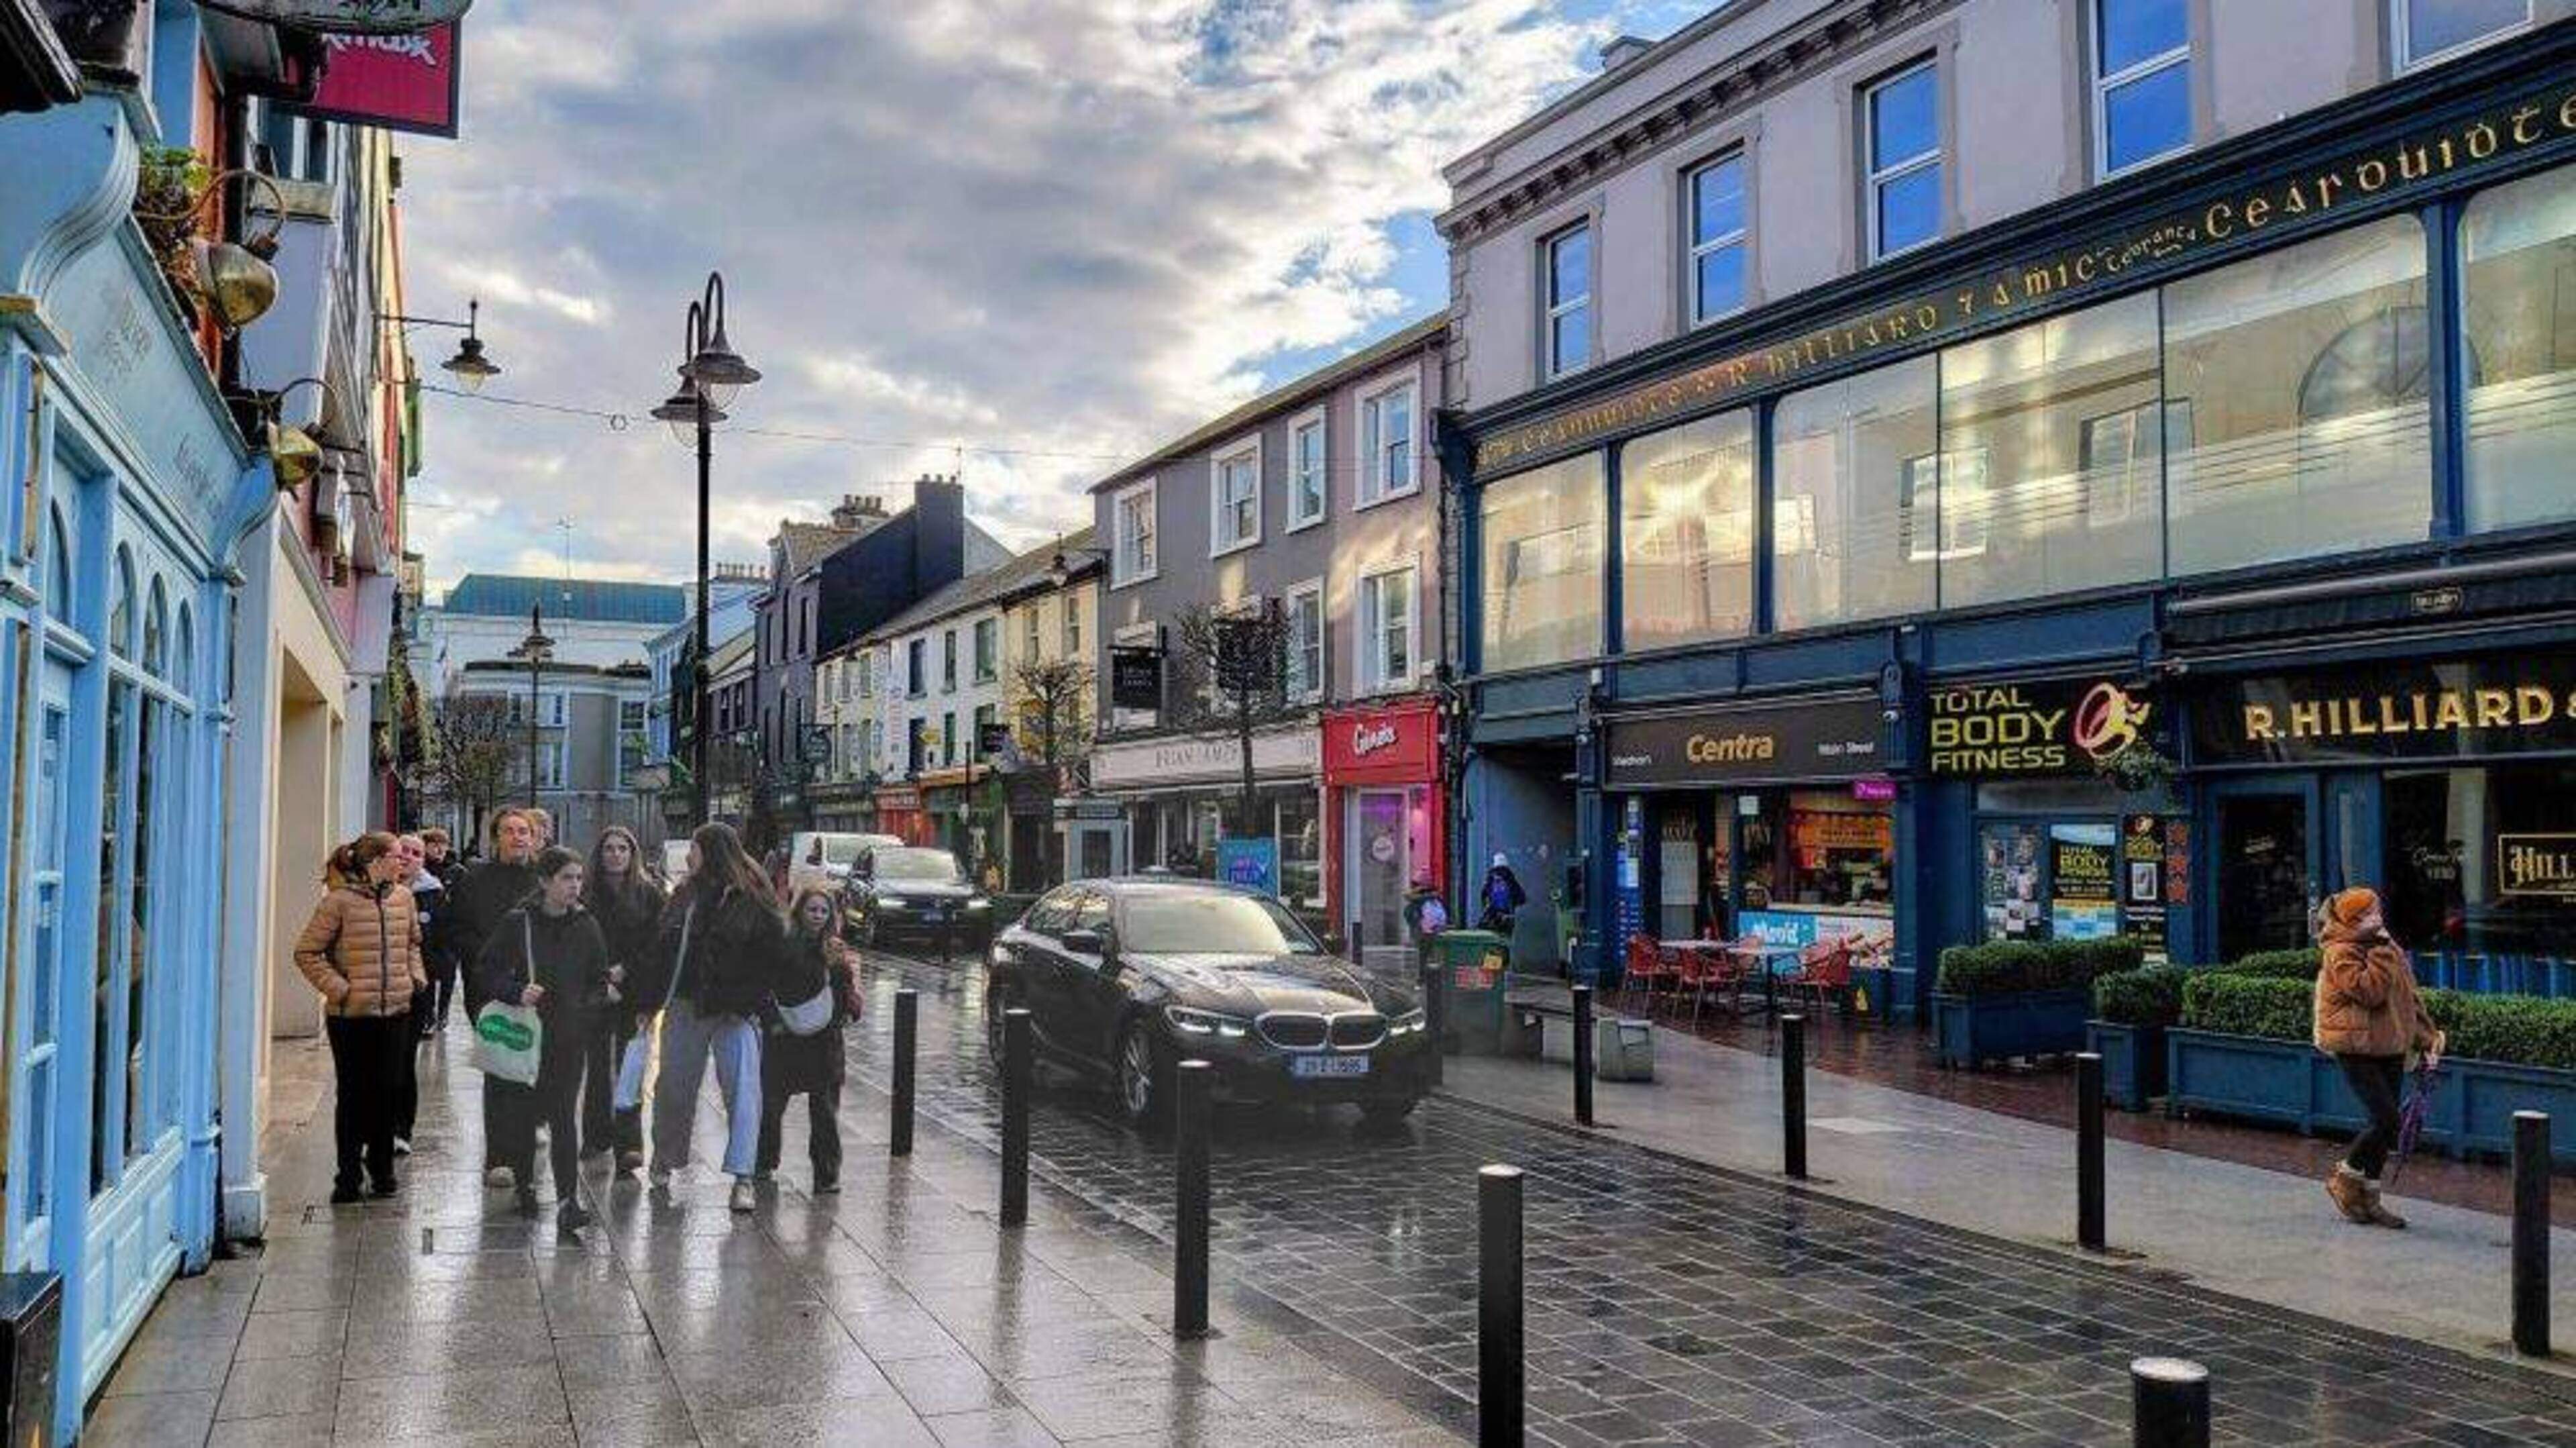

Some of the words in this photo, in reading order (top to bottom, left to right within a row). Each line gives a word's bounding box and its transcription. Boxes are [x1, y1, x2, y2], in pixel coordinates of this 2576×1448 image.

[1930, 687, 2031, 714] TOTAL
[1932, 708, 2065, 748] BODY
[1686, 734, 1774, 763] Centra
[1931, 744, 2065, 773] FITNESS
